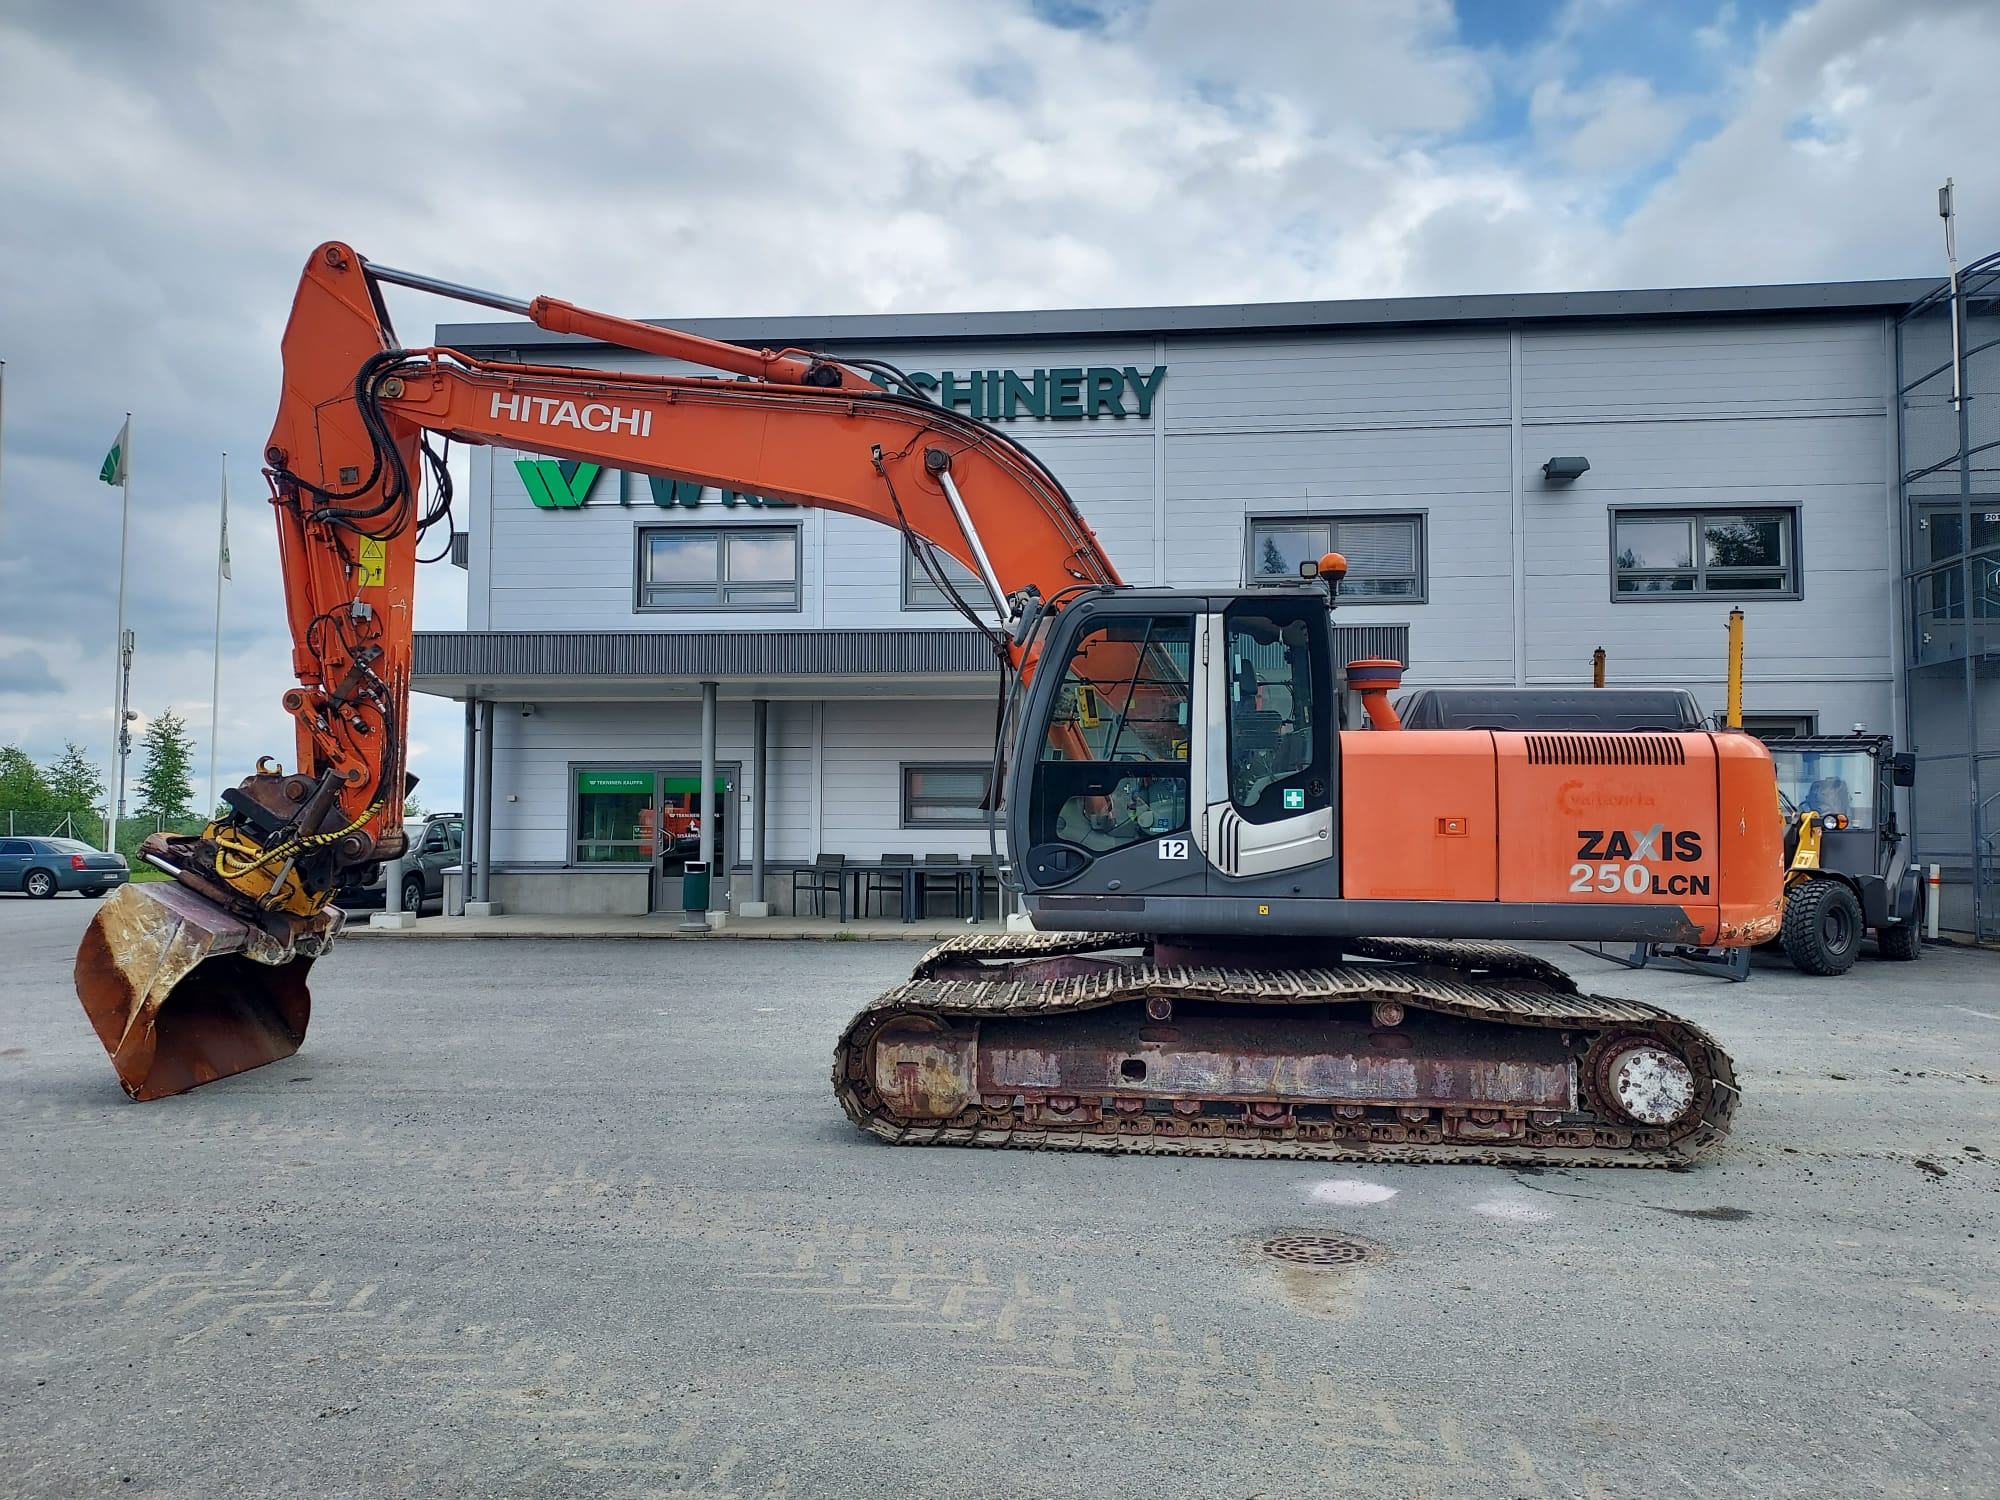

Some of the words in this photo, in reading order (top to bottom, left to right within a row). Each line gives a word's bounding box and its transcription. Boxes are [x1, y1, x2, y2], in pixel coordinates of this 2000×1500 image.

[489, 391, 652, 437] HITACHI
[1162, 841, 1185, 858] 12
[1577, 823, 1702, 862] ZAXIS
